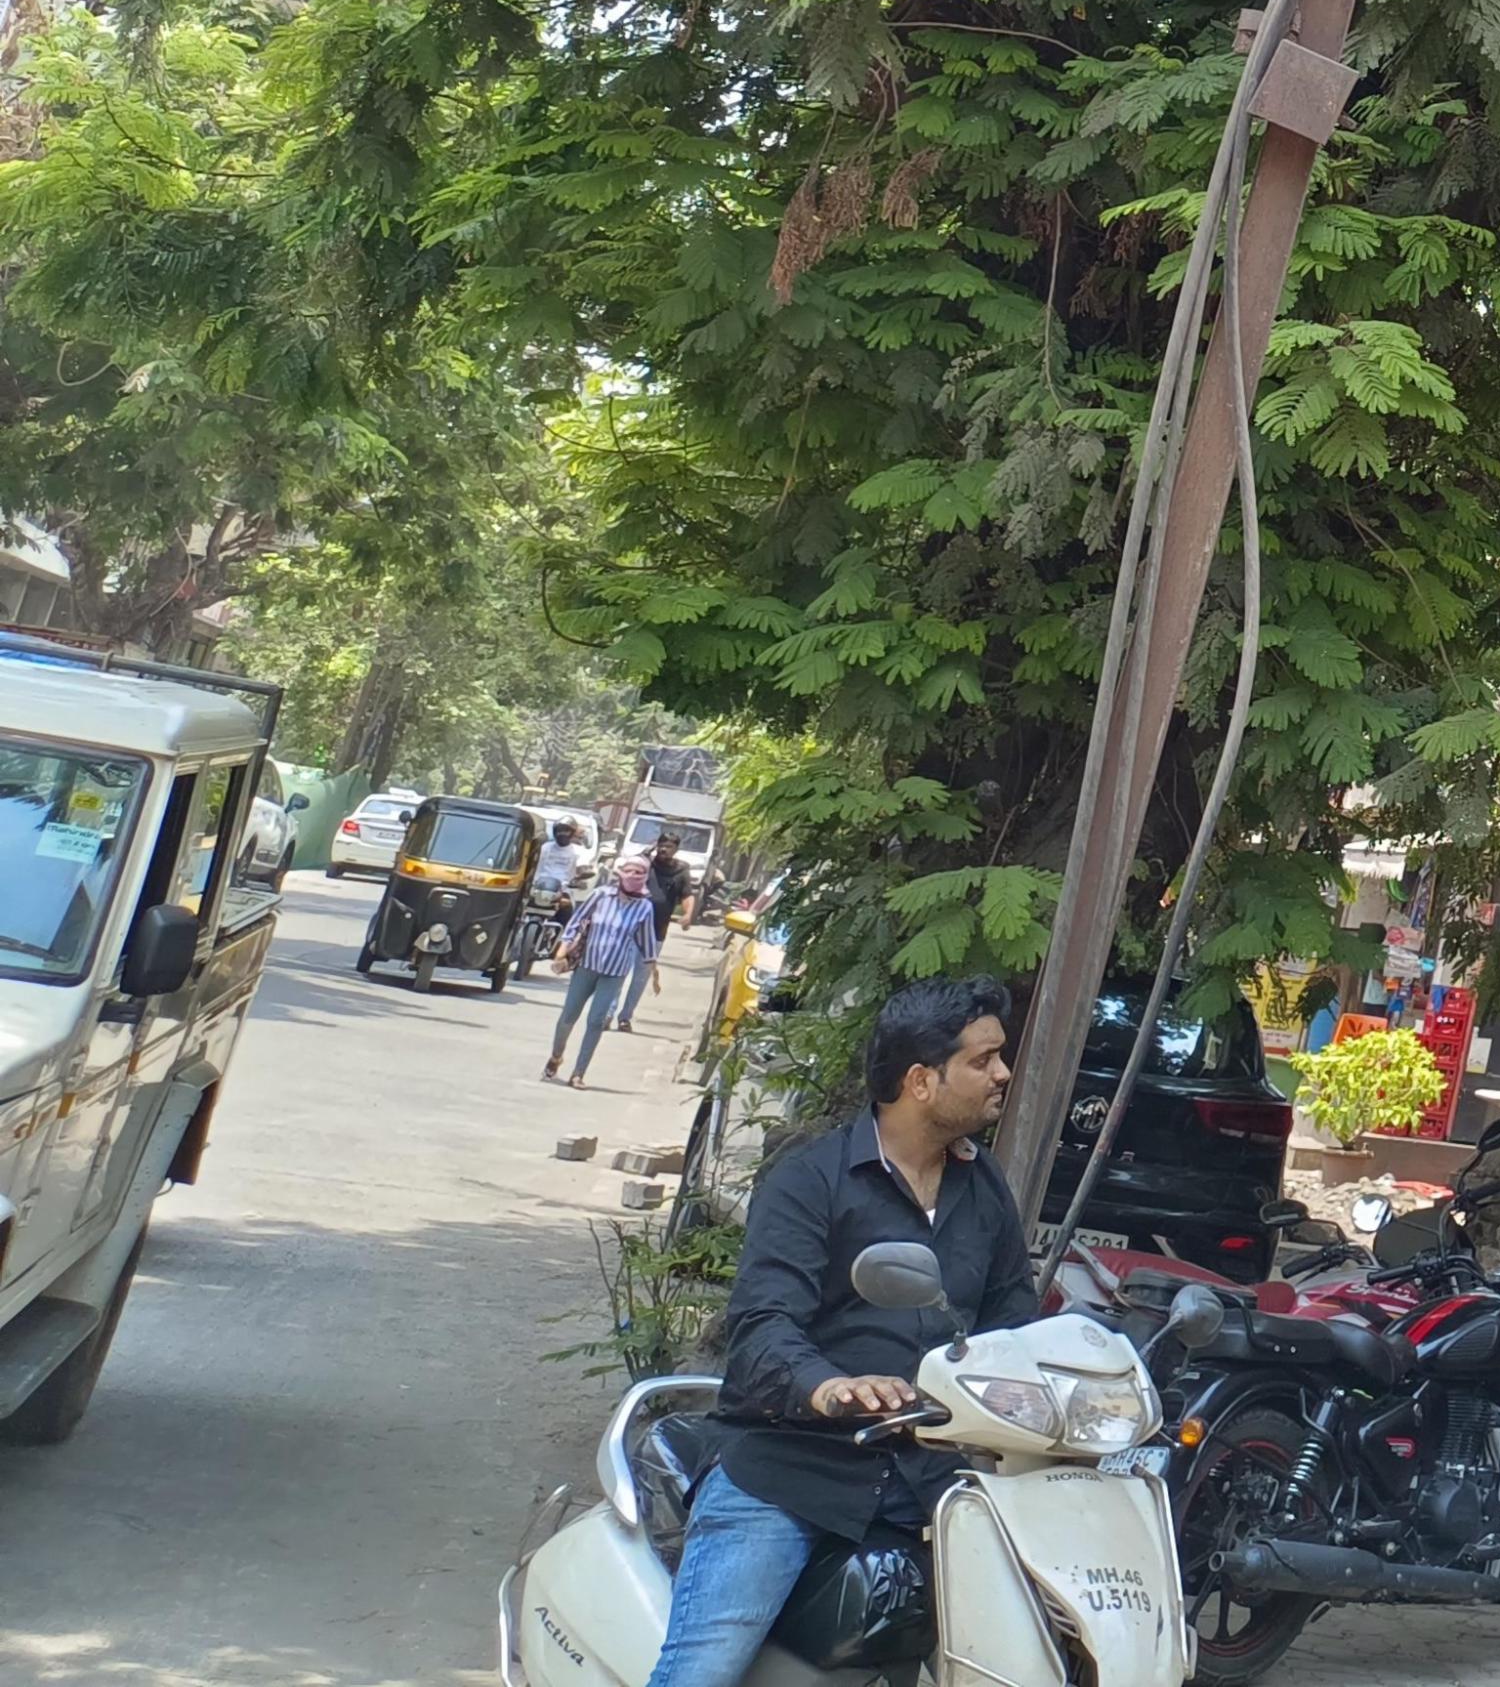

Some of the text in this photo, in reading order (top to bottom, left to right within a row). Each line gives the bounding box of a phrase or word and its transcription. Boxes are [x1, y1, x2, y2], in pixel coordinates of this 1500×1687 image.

[1045, 1471, 1104, 1484] HONDA
[1086, 1567, 1144, 1587] MH.46
[1088, 1588, 1152, 1613] U.5119
[534, 1606, 585, 1668] Activa
